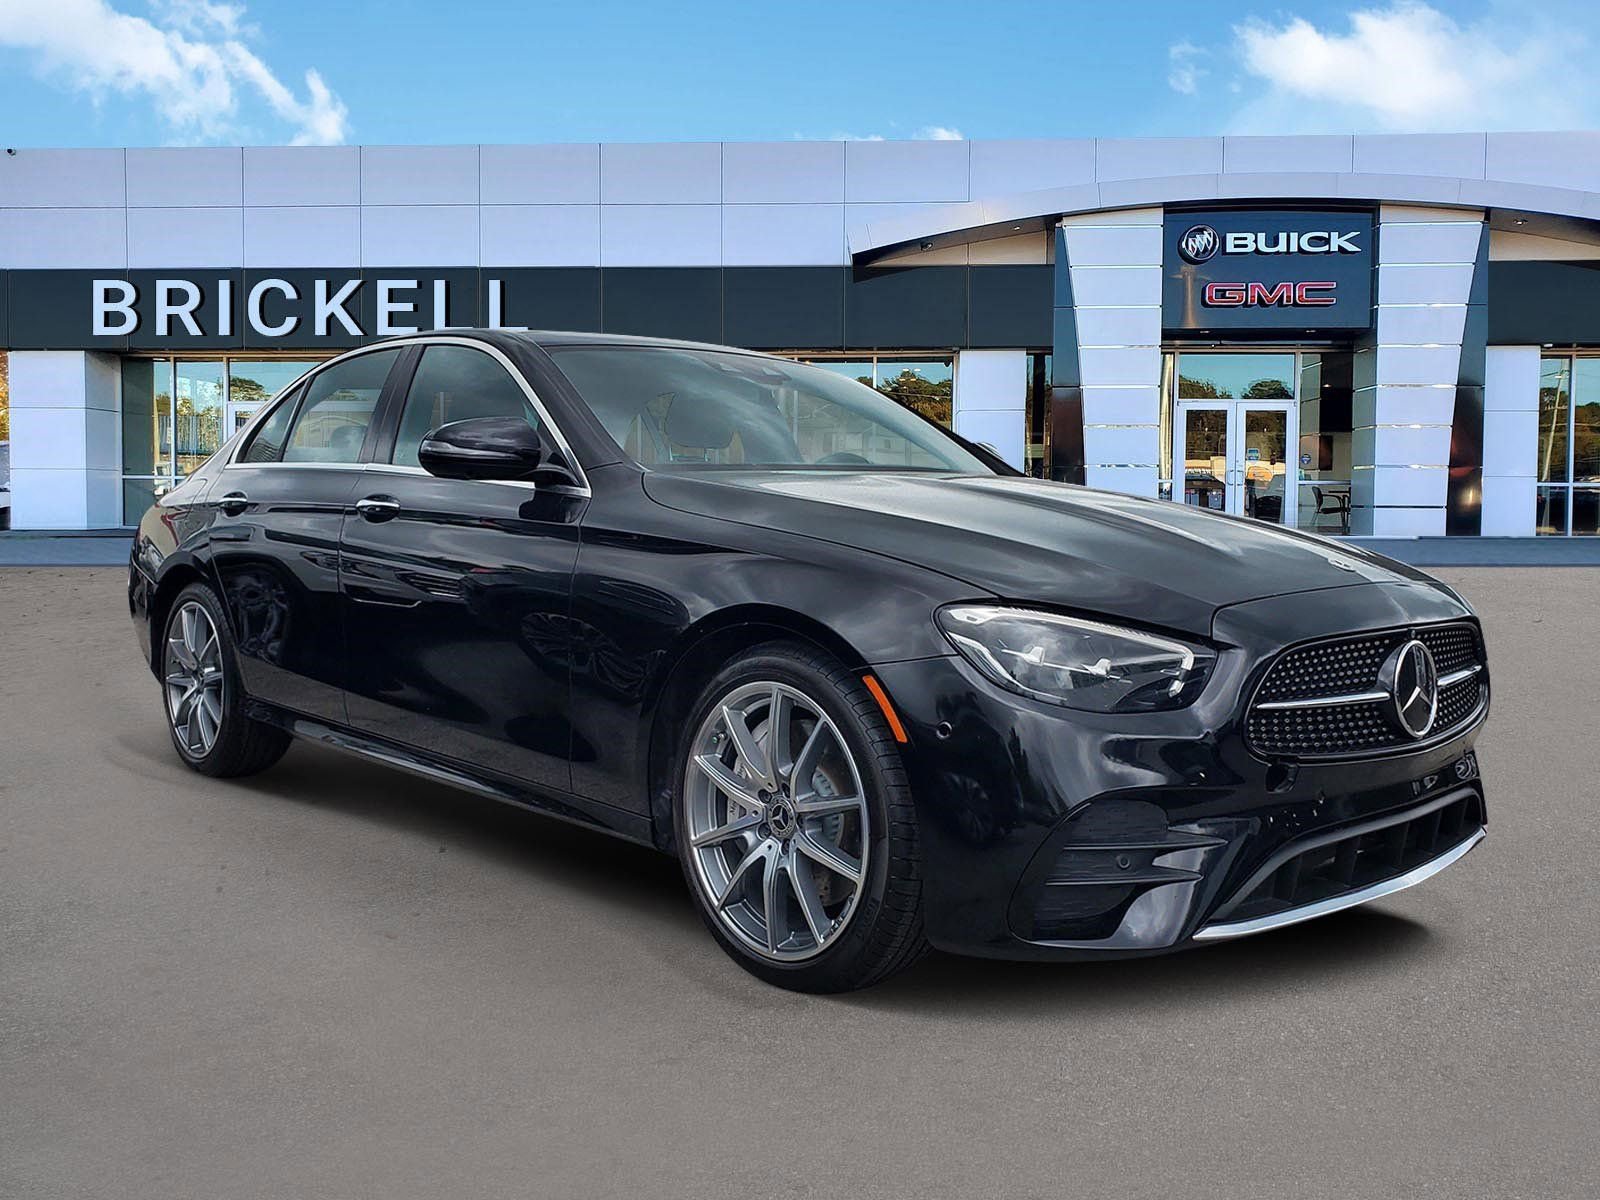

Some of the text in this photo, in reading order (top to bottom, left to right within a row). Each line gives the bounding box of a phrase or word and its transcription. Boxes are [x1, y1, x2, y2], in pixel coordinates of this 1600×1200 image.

[1225, 231, 1362, 253] BUICK
[1204, 281, 1338, 306] GMC
[92, 278, 529, 336] BRICKELL
